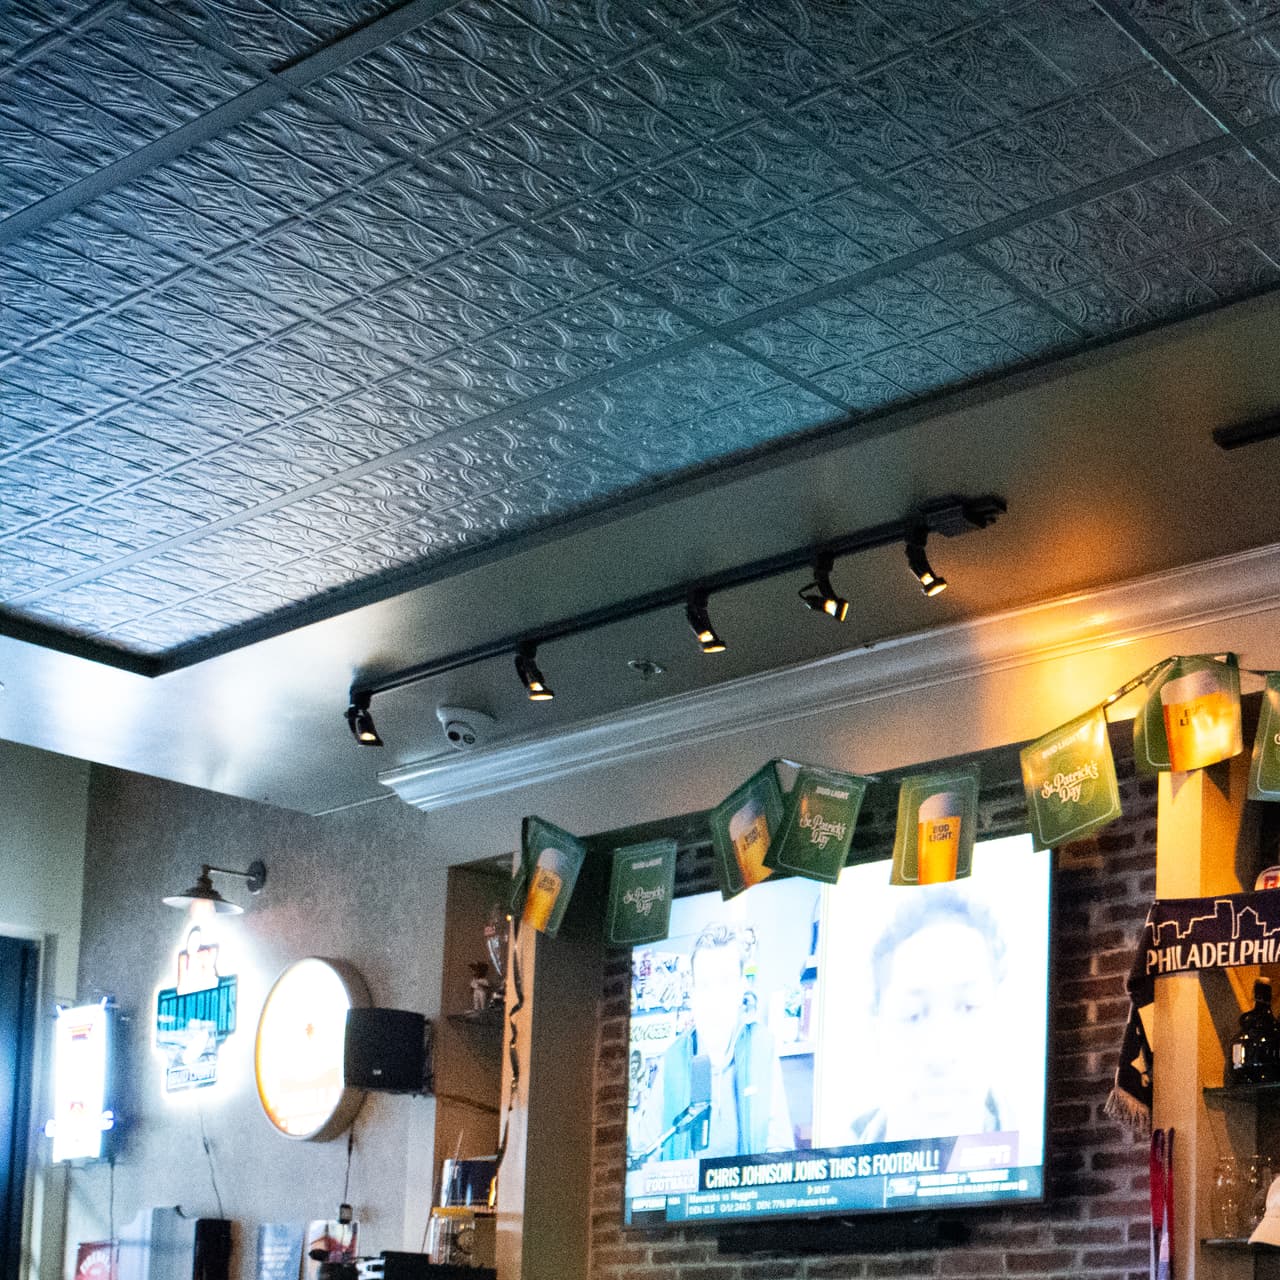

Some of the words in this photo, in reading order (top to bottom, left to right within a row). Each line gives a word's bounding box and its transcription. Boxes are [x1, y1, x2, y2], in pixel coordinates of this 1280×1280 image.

[1060, 784, 1082, 803] Day
[706, 1167, 740, 1189] CHRIS
[741, 1162, 793, 1187] JOHNSON
[794, 1158, 828, 1182] JOINS
[829, 1154, 857, 1179] THIS
[858, 1153, 872, 1176] IS
[872, 1150, 940, 1175] FOOTBALL!
